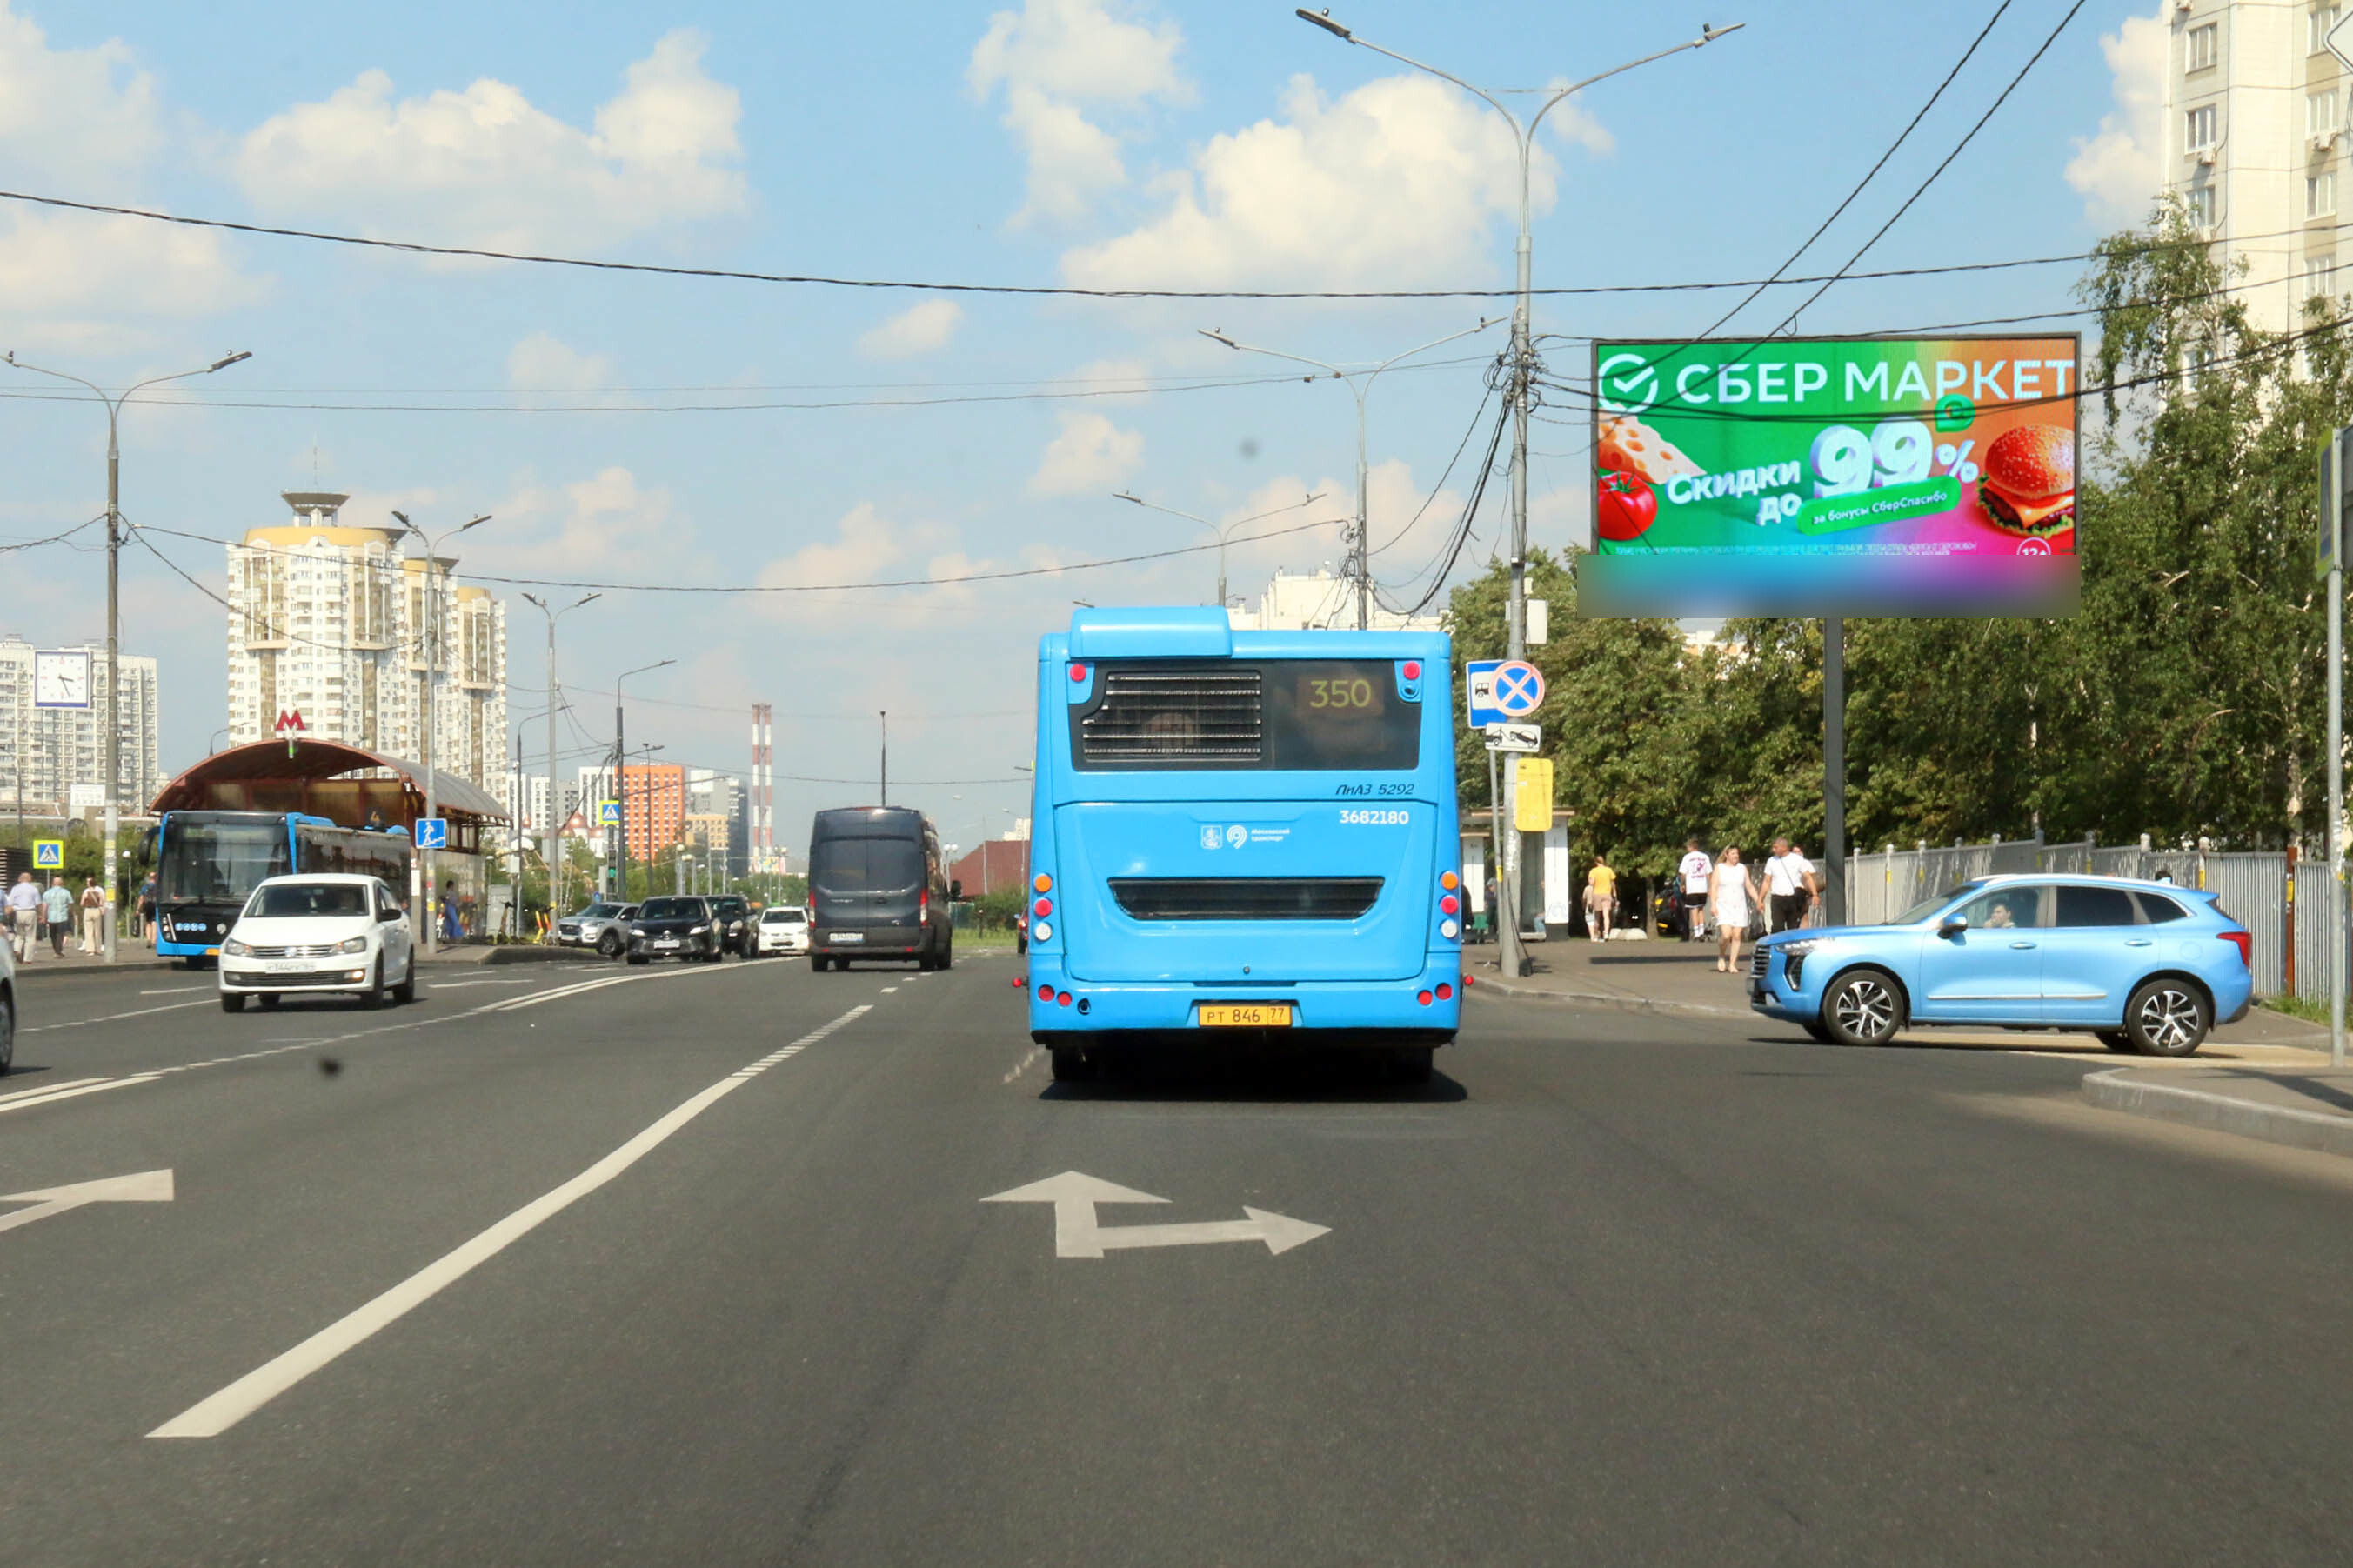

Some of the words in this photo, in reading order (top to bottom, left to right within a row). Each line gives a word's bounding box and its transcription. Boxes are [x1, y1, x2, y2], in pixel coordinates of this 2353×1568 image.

[1676, 363, 1828, 404] СБЕР
[1845, 359, 2075, 401] МАРКЕТ
[1666, 460, 1801, 504] Скидки
[1756, 492, 1802, 526] до
[1813, 512, 1827, 524] за
[1828, 504, 1870, 523] бонусы
[1871, 490, 1948, 515] СберСпасибо
[1309, 678, 1372, 709] 350
[1335, 784, 1373, 797] ЛиАЗ
[1378, 783, 1415, 796] 5292
[1339, 810, 1409, 825] 3682180
[1207, 1011, 1225, 1024] РТ
[1232, 1008, 1260, 1024] 846
[1270, 1007, 1285, 1019] 77
